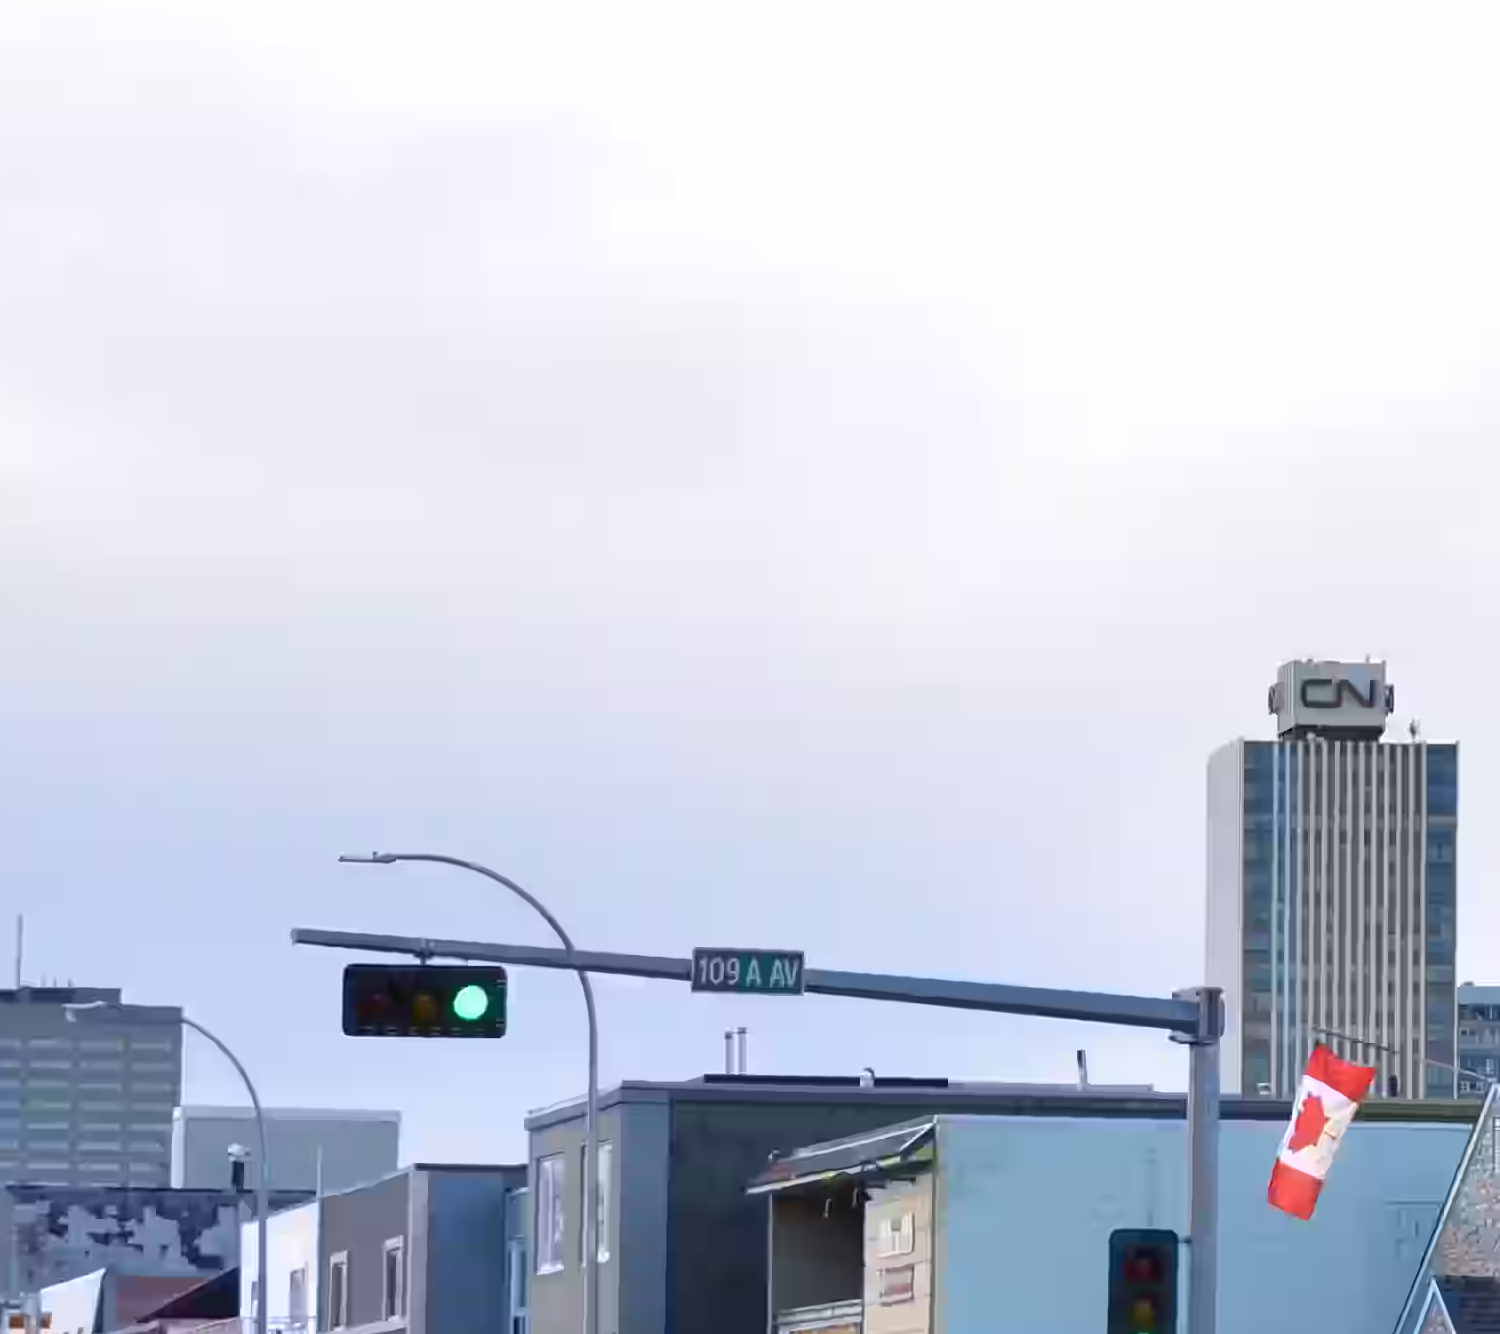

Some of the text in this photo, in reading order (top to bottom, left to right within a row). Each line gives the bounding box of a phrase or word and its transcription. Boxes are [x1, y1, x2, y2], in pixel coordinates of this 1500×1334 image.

[1300, 678, 1378, 709] CN
[700, 957, 800, 987] 109 A AV
